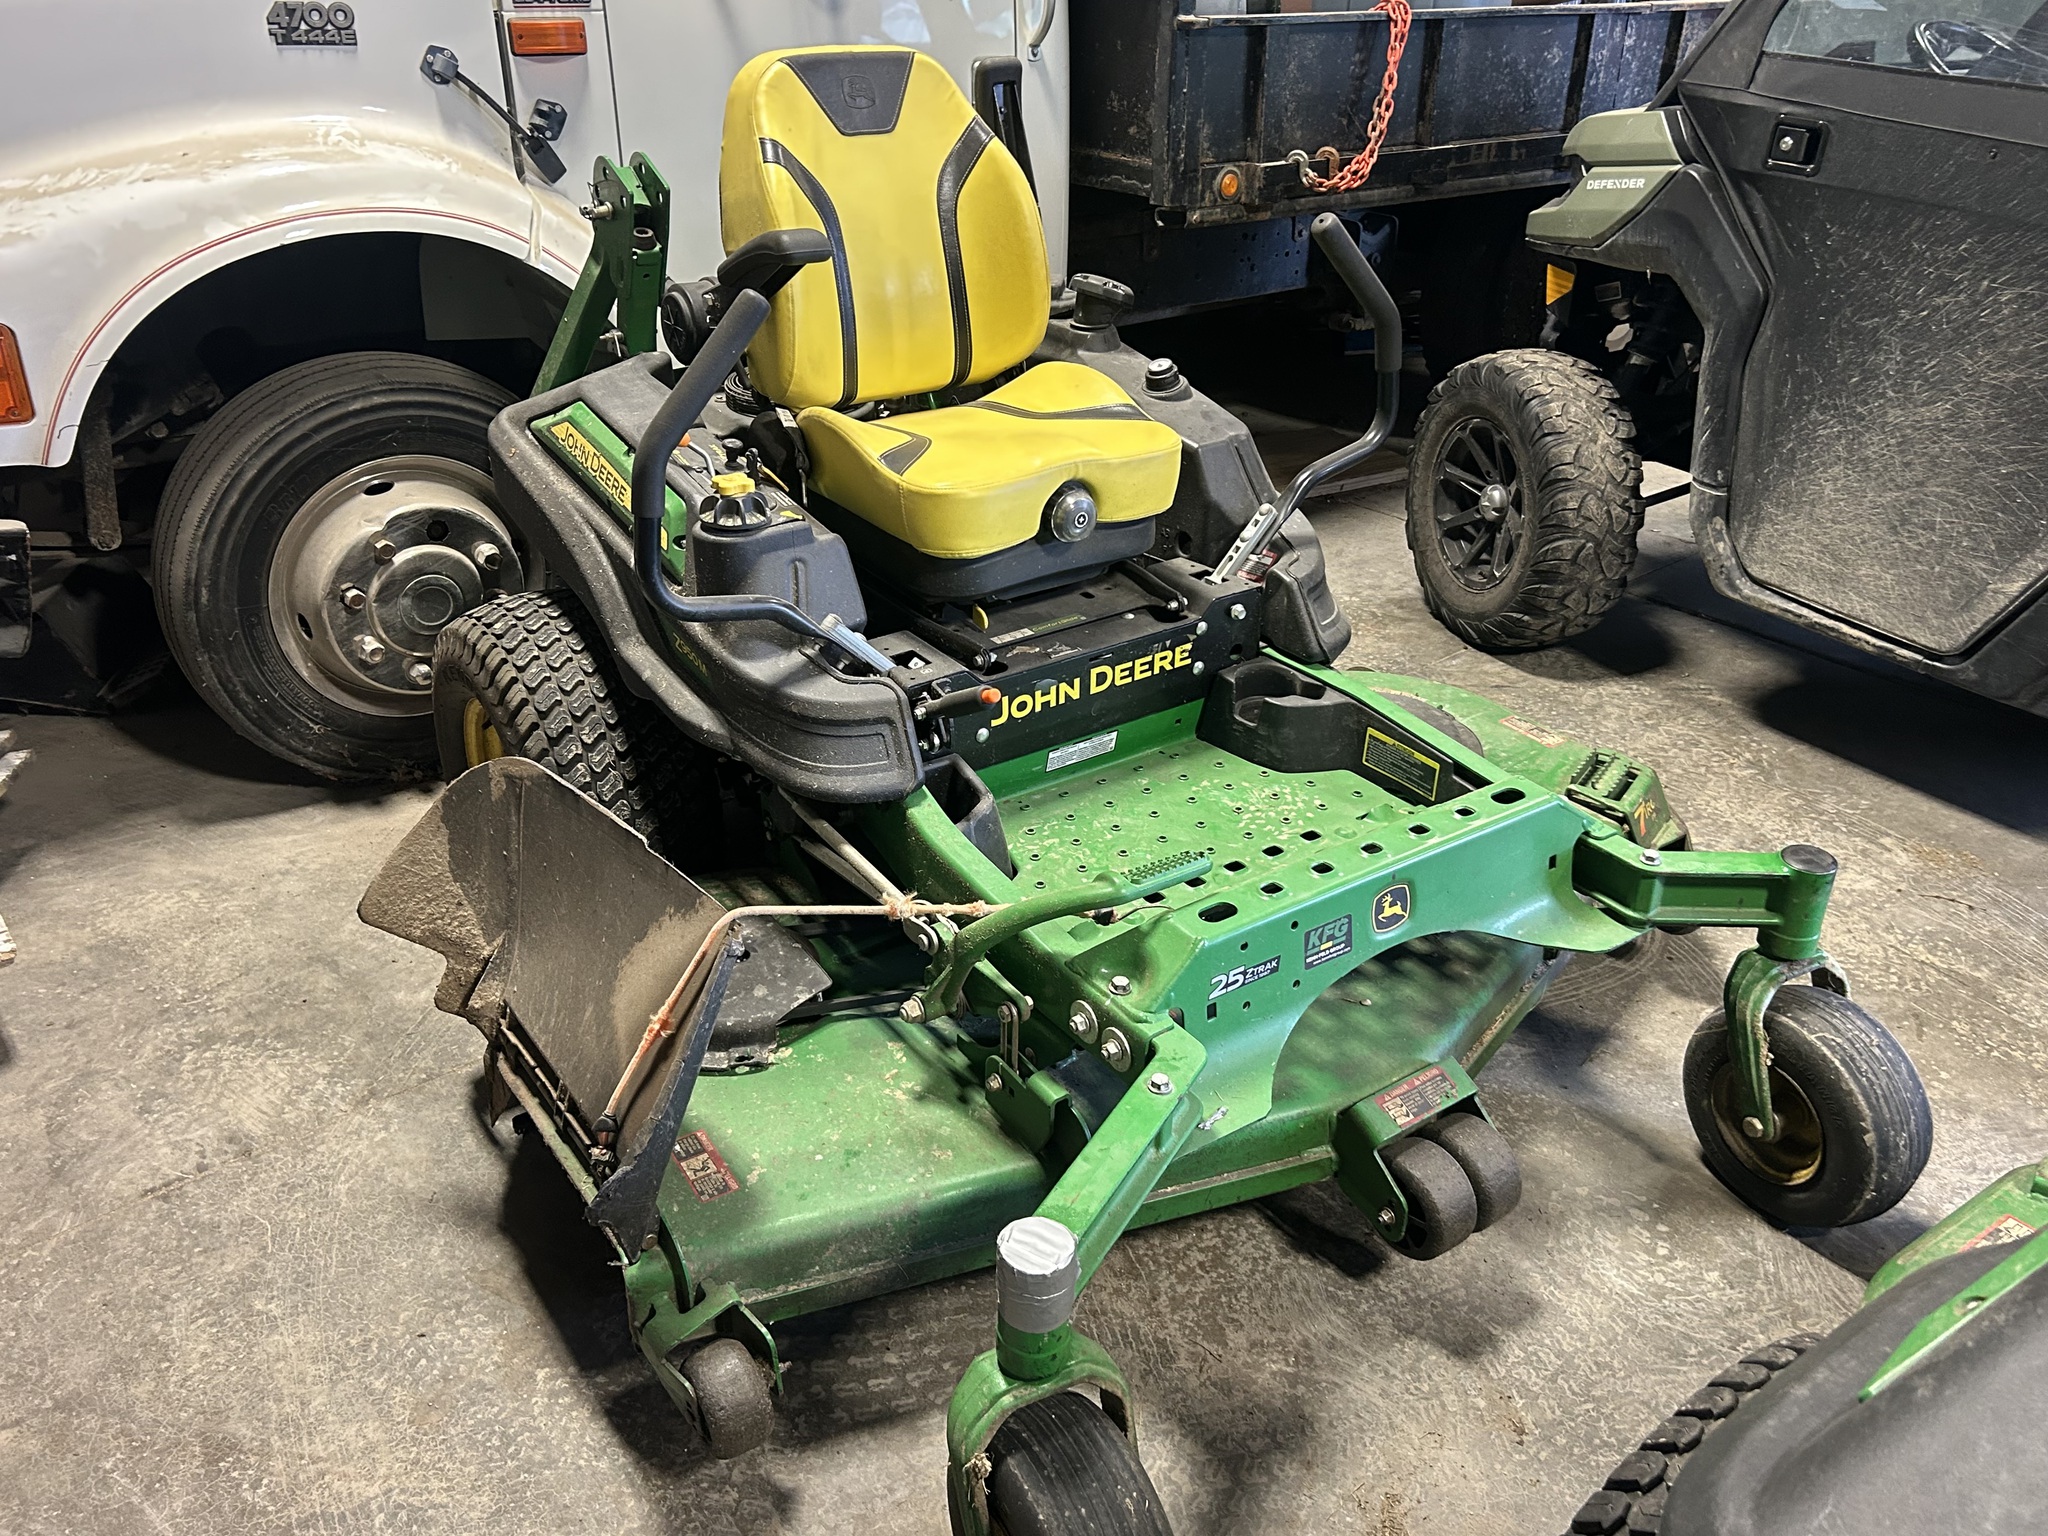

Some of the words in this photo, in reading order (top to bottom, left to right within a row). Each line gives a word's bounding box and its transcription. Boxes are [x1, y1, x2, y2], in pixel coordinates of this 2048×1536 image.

[266, 1, 355, 29] 4700
[268, 29, 287, 44] T
[291, 29, 357, 45] 444E
[1586, 178, 1646, 190] DEFENDER
[560, 426, 590, 469] JOHN
[589, 453, 628, 504] DEERE
[990, 677, 1081, 728] JOHN
[1089, 641, 1194, 695] DEERE
[1307, 917, 1349, 950] KFG
[1208, 965, 1246, 1000] 25
[1245, 958, 1278, 979] ZTRAK
